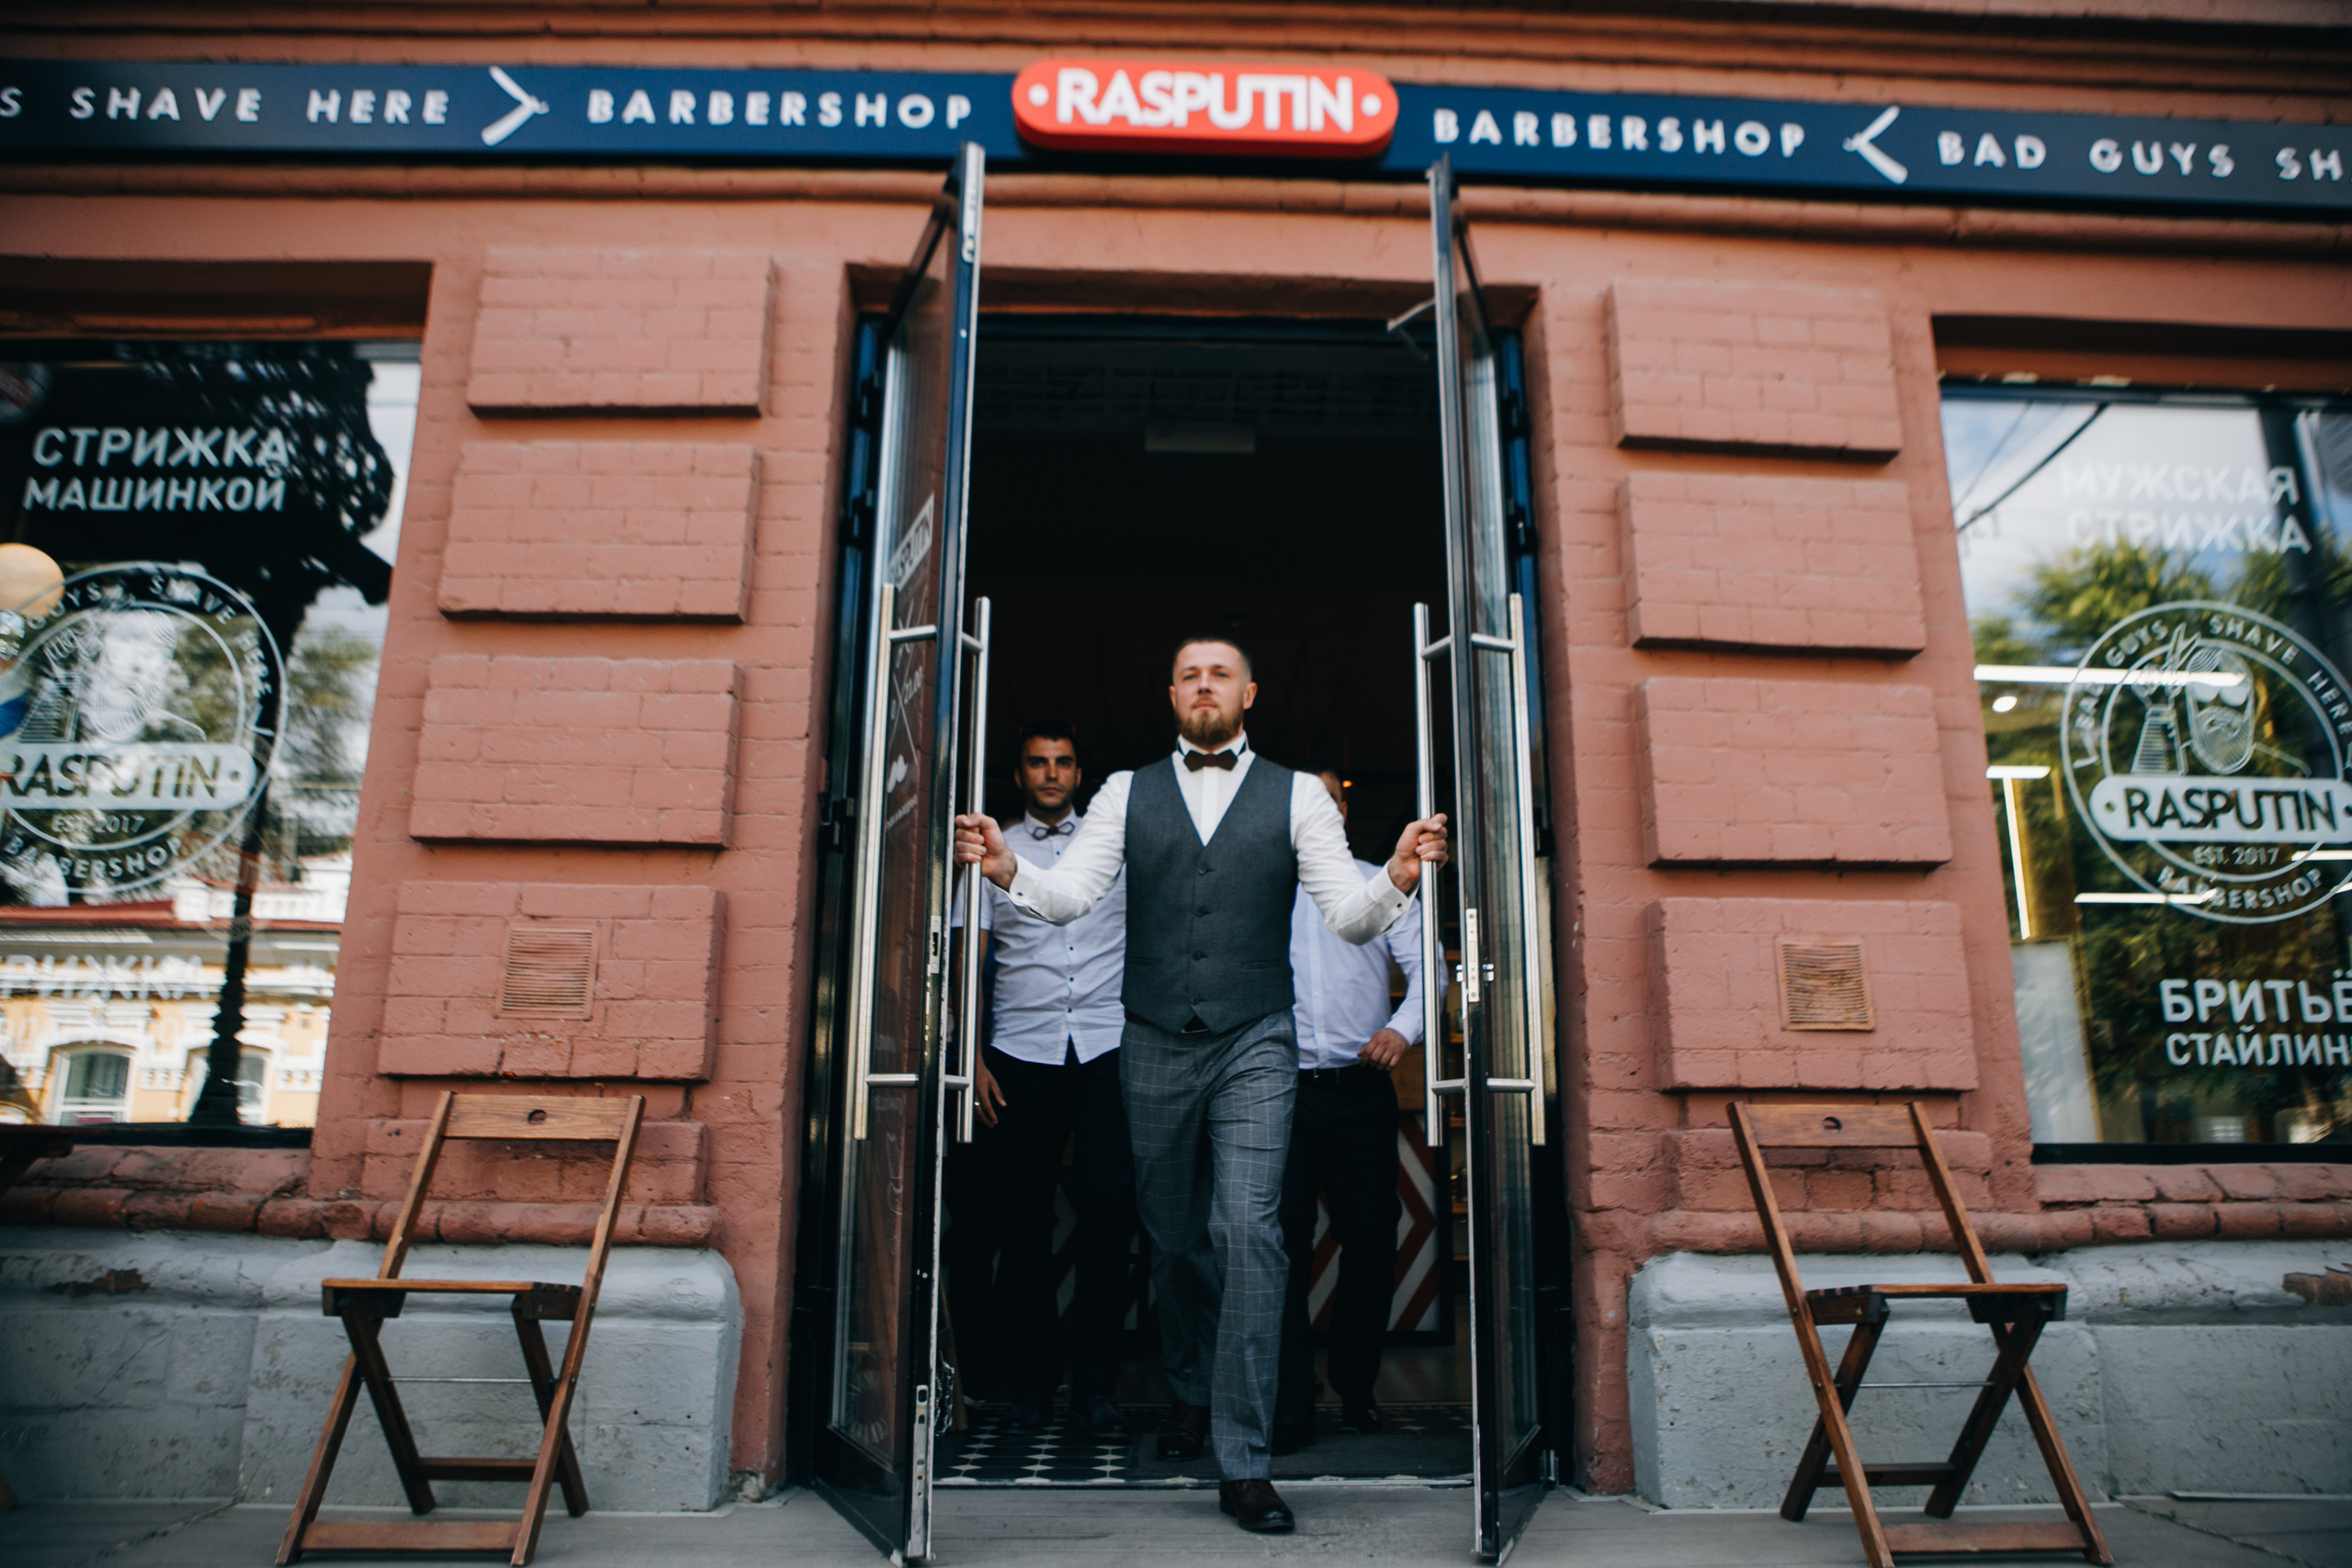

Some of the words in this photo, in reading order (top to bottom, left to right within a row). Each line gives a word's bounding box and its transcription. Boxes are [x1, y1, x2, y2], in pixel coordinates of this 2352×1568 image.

[69, 86, 262, 123] SHAVE
[306, 88, 449, 125] HERE
[587, 88, 972, 130] BARBERSHOP
[1056, 67, 1353, 134] RASPUTIN
[1432, 107, 1805, 158] BARBERSHOP
[1937, 130, 2047, 169] BAD
[2088, 138, 2235, 179] GUYS
[2275, 146, 2352, 182] SH
[32, 426, 290, 468] СТРИЖКА
[22, 463, 288, 513] МАШИНКОЙ
[2059, 462, 2300, 507] МУЖСКАЯ
[2066, 509, 2312, 555] СТРИЖКА
[2105, 618, 2169, 668] GUYS
[2209, 614, 2300, 666] SHAVE
[2123, 786, 2339, 832] RASPUTIN
[3, 835, 183, 880] BABERSHOP
[2232, 845, 2280, 866] 2017
[2165, 1023, 2352, 1066] СТАЙЛИН
